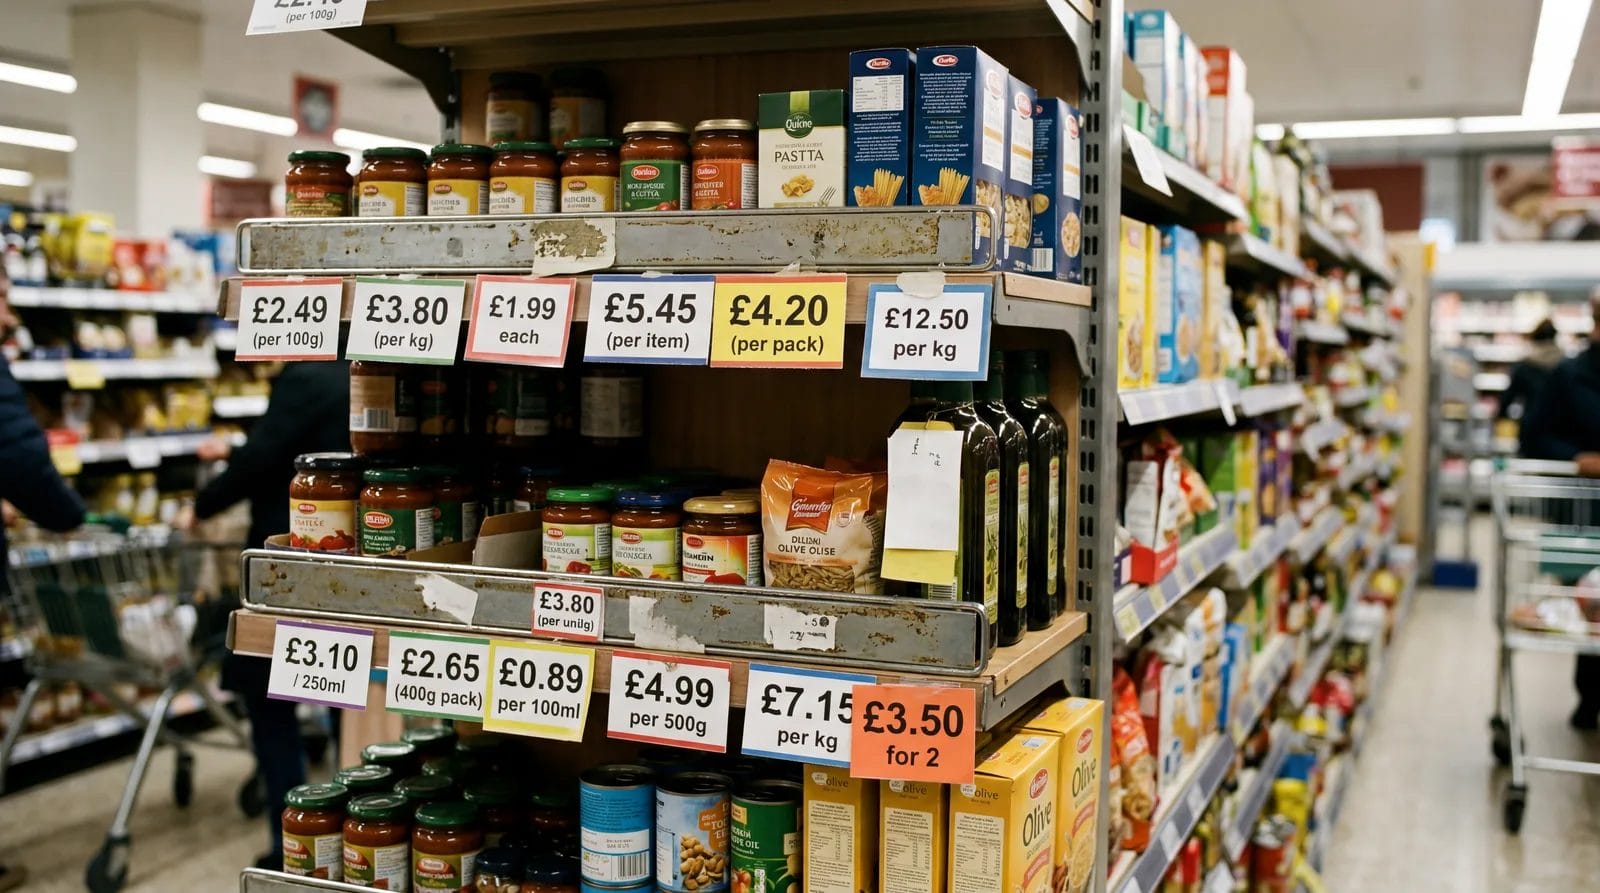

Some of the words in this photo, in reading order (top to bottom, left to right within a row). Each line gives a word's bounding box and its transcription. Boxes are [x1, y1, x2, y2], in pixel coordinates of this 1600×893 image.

[286, 13, 307, 24] (per
[310, 8, 337, 21] 100g)
[775, 149, 825, 163] PASTTA
[252, 296, 327, 323] £2.49
[366, 294, 448, 325] £3.80
[489, 295, 556, 320] £1.99
[604, 293, 696, 323] £5.45
[730, 295, 828, 326] £4.20
[885, 308, 968, 330] £12.50
[253, 332, 281, 349] (per
[286, 331, 324, 349] 100g)
[374, 330, 405, 349] (per
[409, 332, 434, 351] kg)
[500, 330, 539, 344] each
[606, 332, 641, 350] (per
[647, 333, 690, 352] item)
[731, 336, 768, 355] (per
[773, 336, 824, 356] pack)
[894, 343, 926, 361] per
[933, 342, 957, 361] kg
[778, 544, 806, 554] OLIVE
[808, 546, 836, 556] OLISE
[540, 591, 595, 614] £3.80
[538, 614, 560, 627] (per
[286, 638, 358, 671] £3.10
[401, 648, 479, 682] £2.65
[293, 673, 299, 687] /
[302, 674, 345, 694] 250ml
[500, 658, 583, 693] £0.89
[395, 683, 435, 705] (400g
[441, 690, 482, 711] pack)
[625, 669, 714, 707] £4.99
[498, 699, 526, 714] per
[532, 699, 580, 719] 100ml
[761, 684, 852, 724] £7.15
[630, 711, 659, 728] per
[664, 713, 707, 737] 500g
[863, 701, 963, 738] £3.50
[778, 729, 809, 746] per
[815, 730, 838, 753] kg
[886, 745, 919, 766] for
[925, 747, 940, 768] 2
[826, 776, 849, 788] olive
[903, 783, 928, 796] olive
[1073, 758, 1097, 798] Olive
[975, 788, 999, 801] olive
[1023, 801, 1052, 847] Olive
